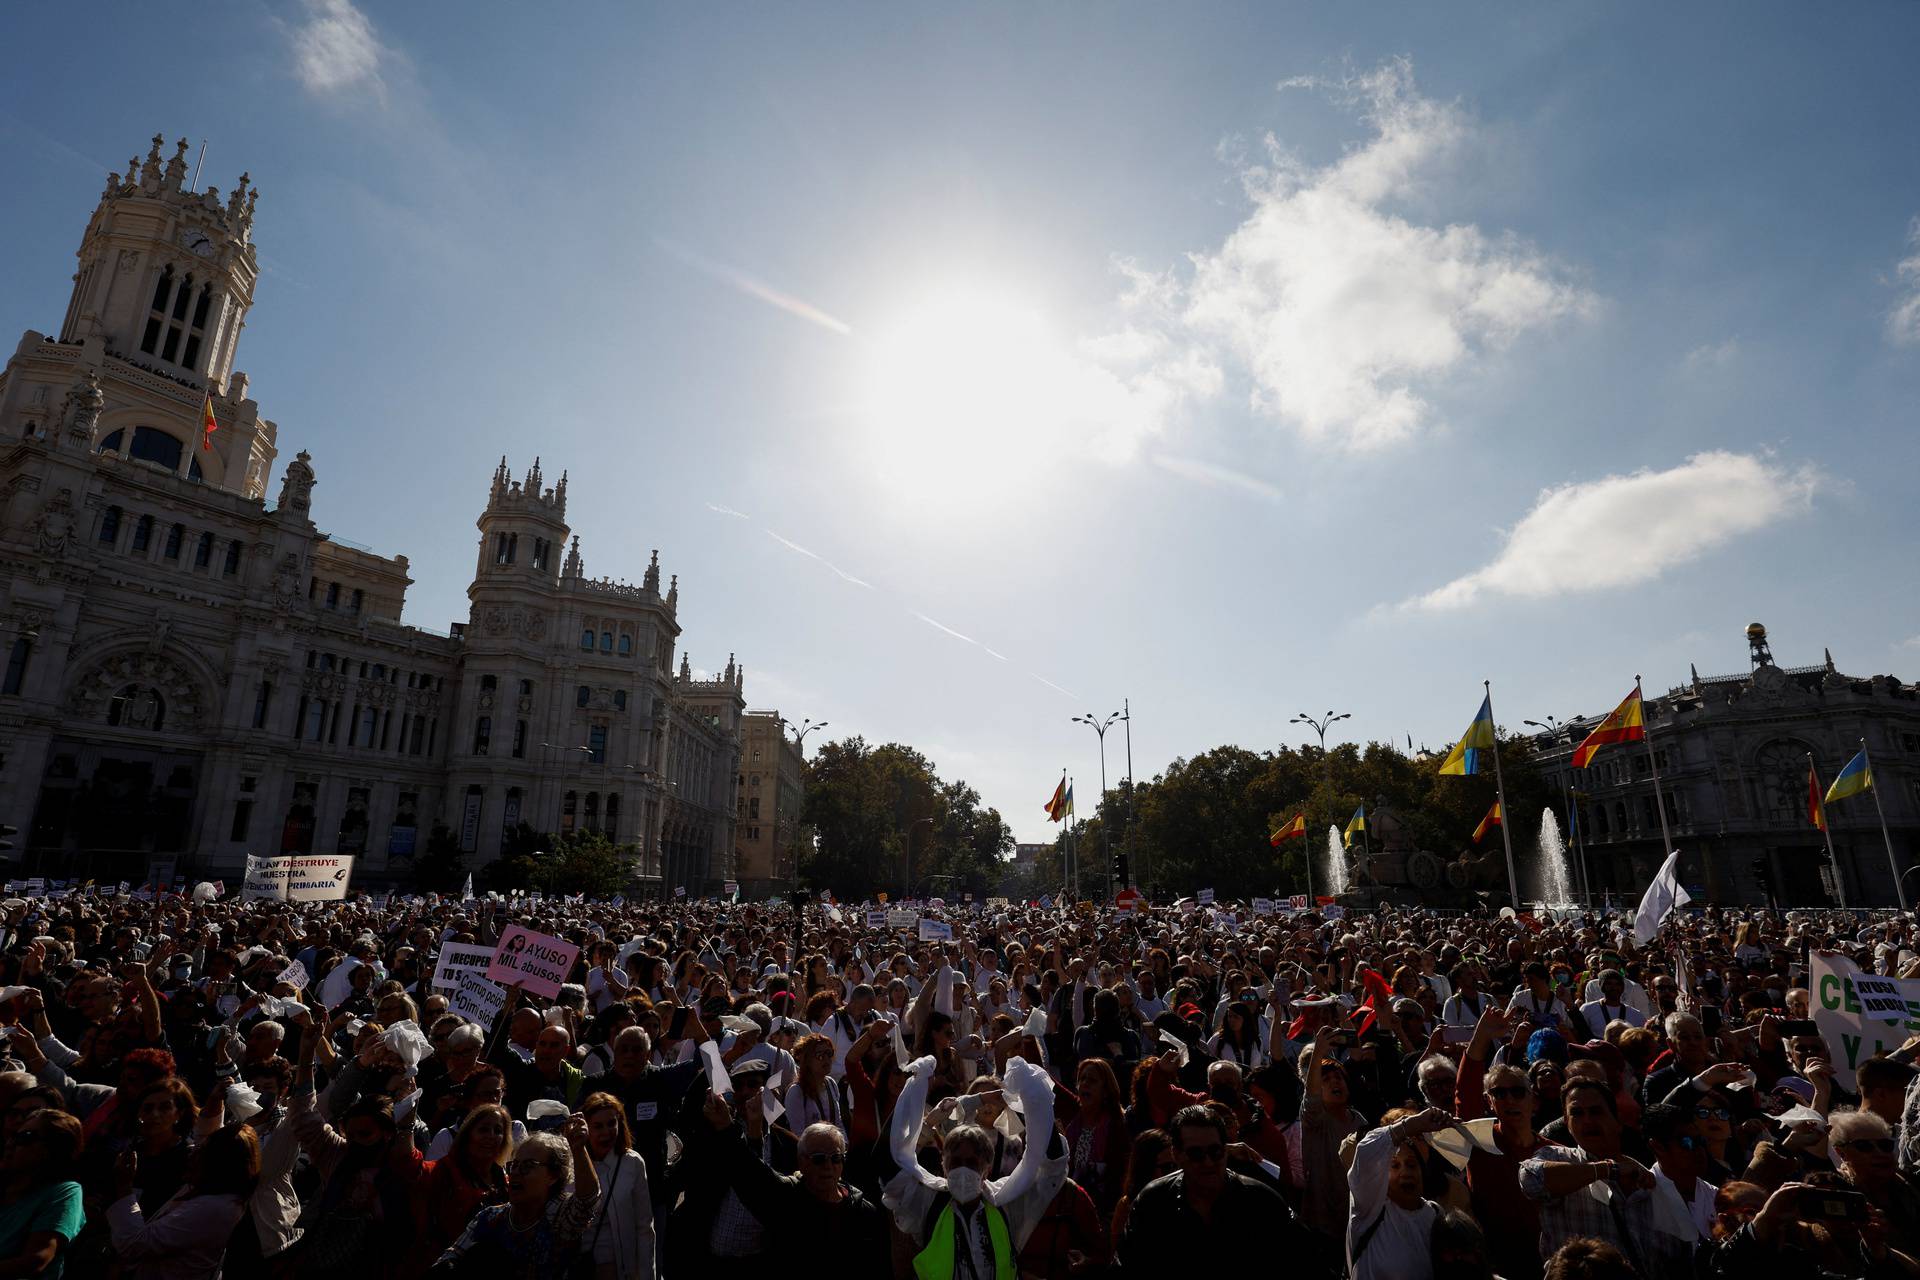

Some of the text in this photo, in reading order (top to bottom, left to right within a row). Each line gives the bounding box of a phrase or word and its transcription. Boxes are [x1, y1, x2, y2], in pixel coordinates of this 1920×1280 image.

[283, 859, 339, 868] DESTRUYE
[260, 870, 305, 879] NUESTRA
[287, 881, 336, 890] PRIMARIA
[497, 953, 518, 970] MIL
[442, 968, 455, 981] TU
